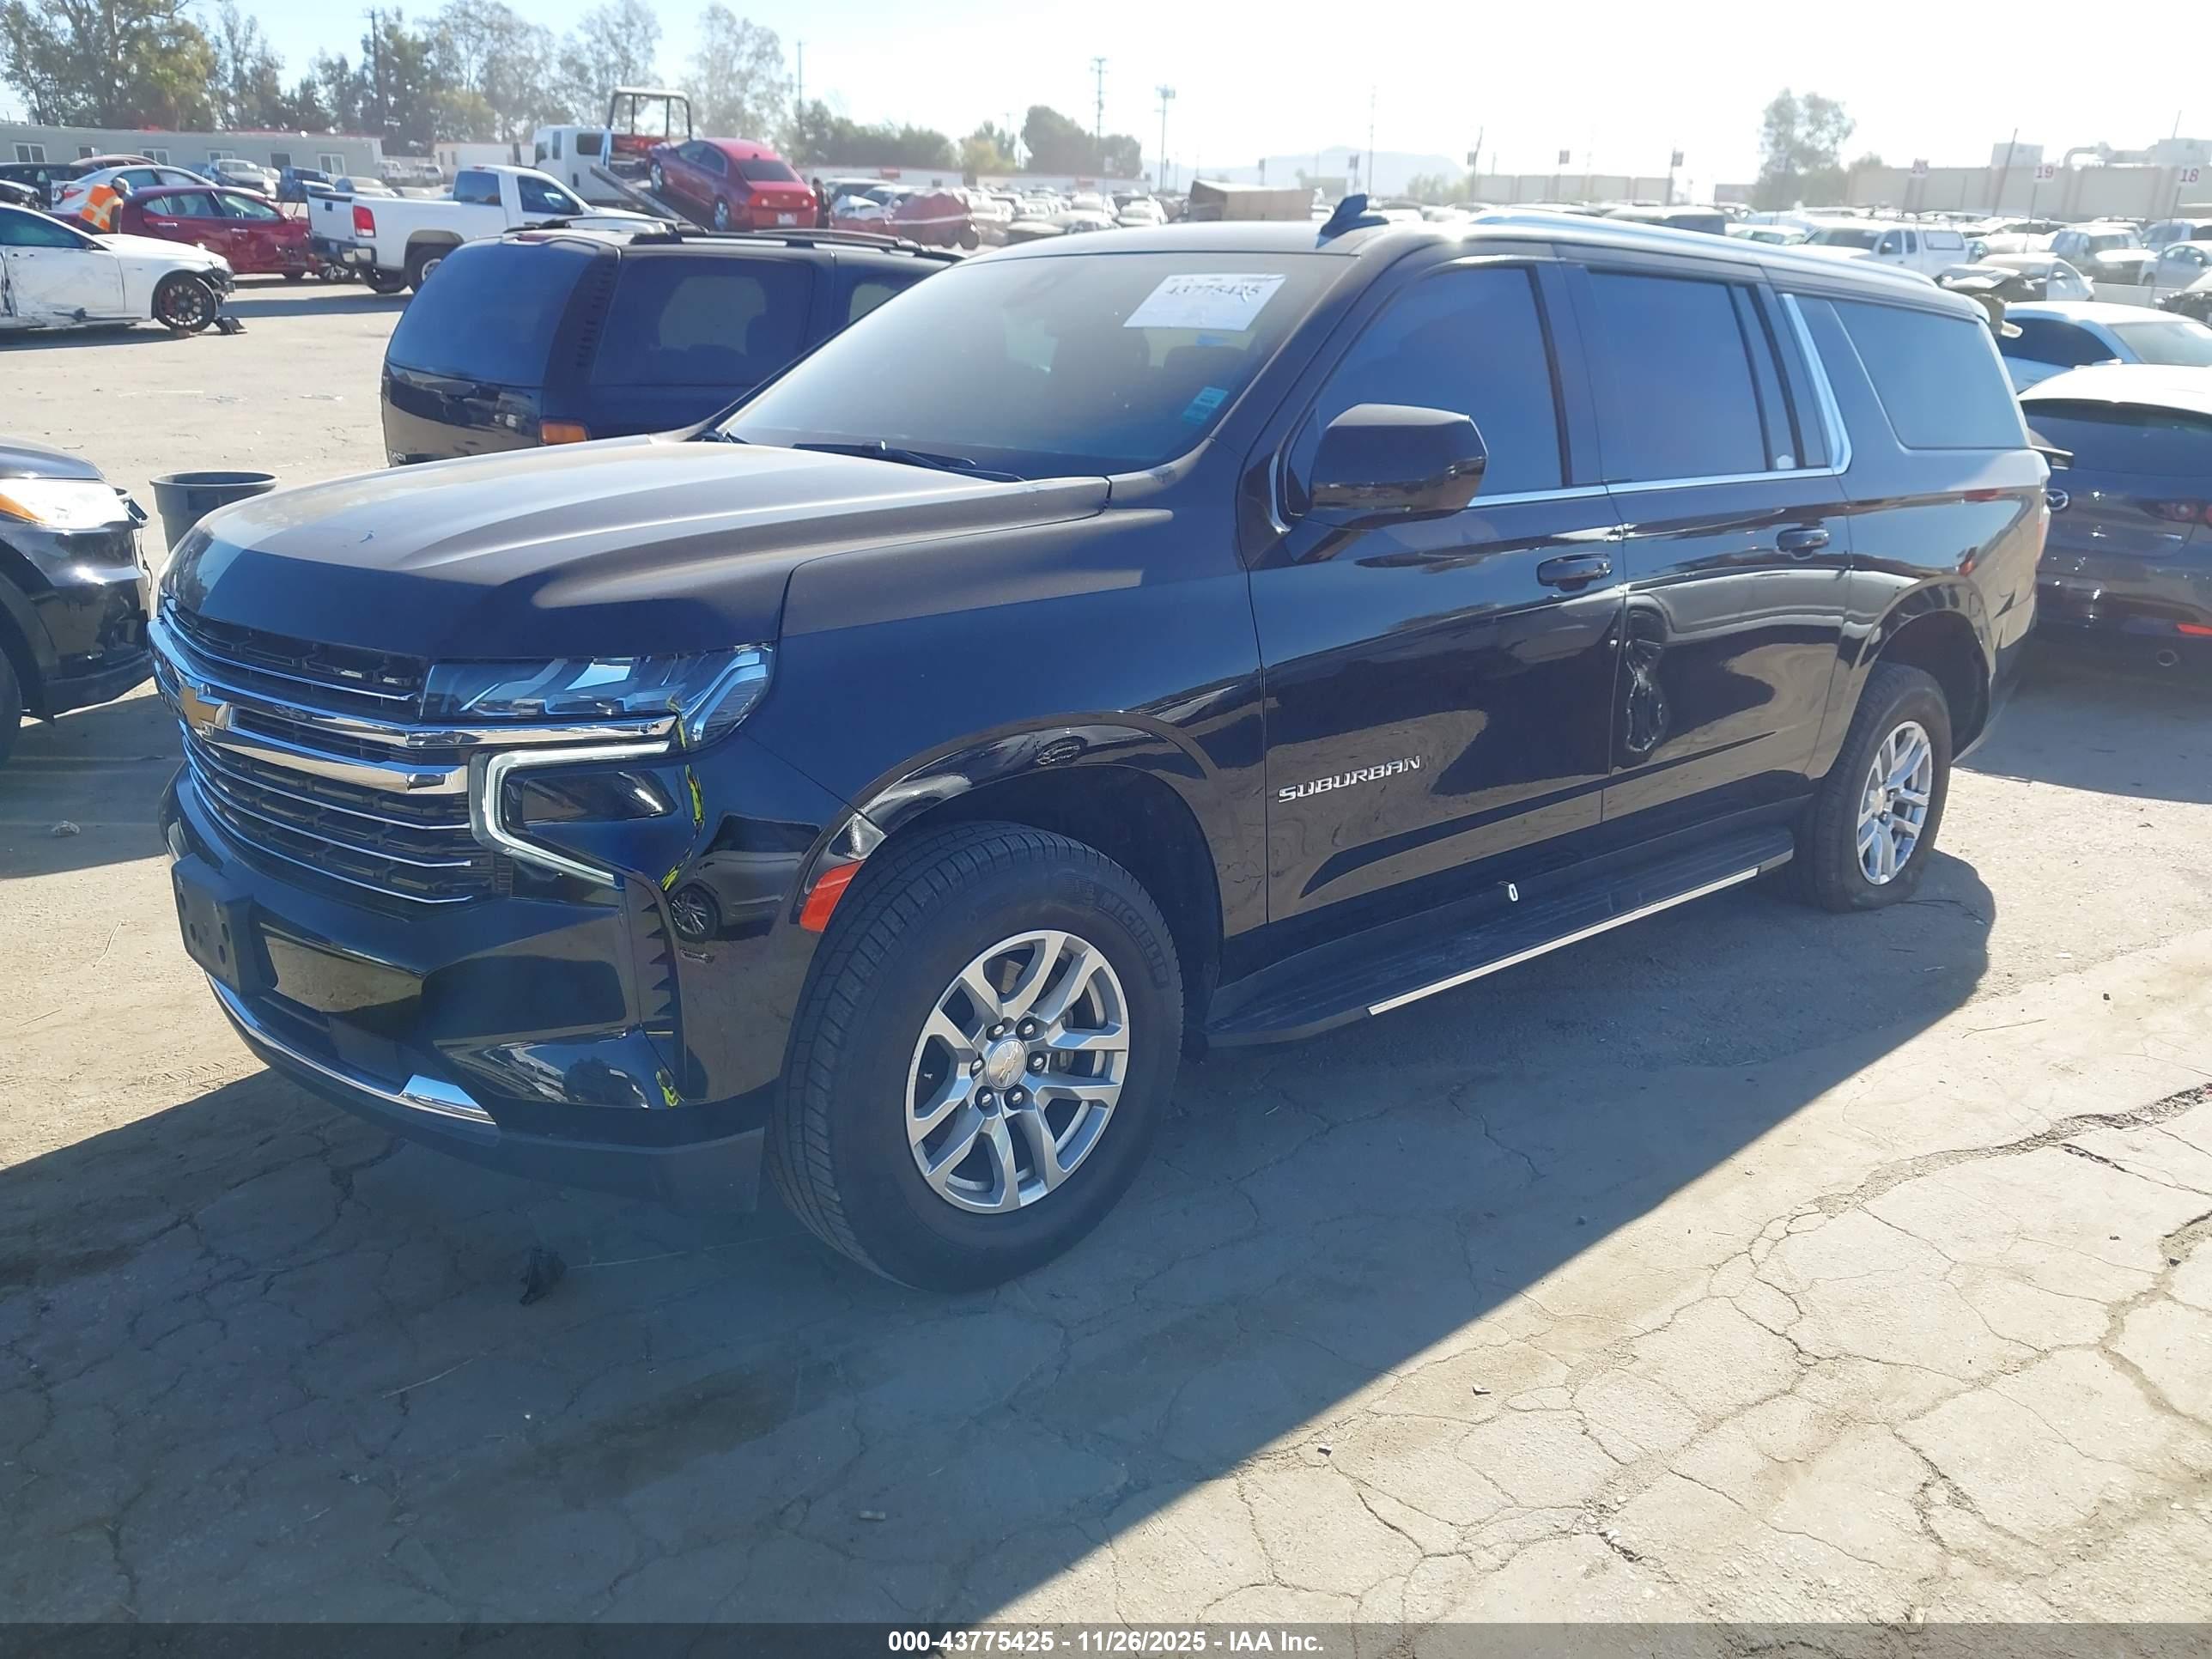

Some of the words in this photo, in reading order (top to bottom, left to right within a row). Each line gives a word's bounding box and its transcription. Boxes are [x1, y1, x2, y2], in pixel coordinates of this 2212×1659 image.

[2035, 165, 2054, 179] 19
[2179, 167, 2199, 183] 18
[1278, 755, 1420, 803] SUBURBAN
